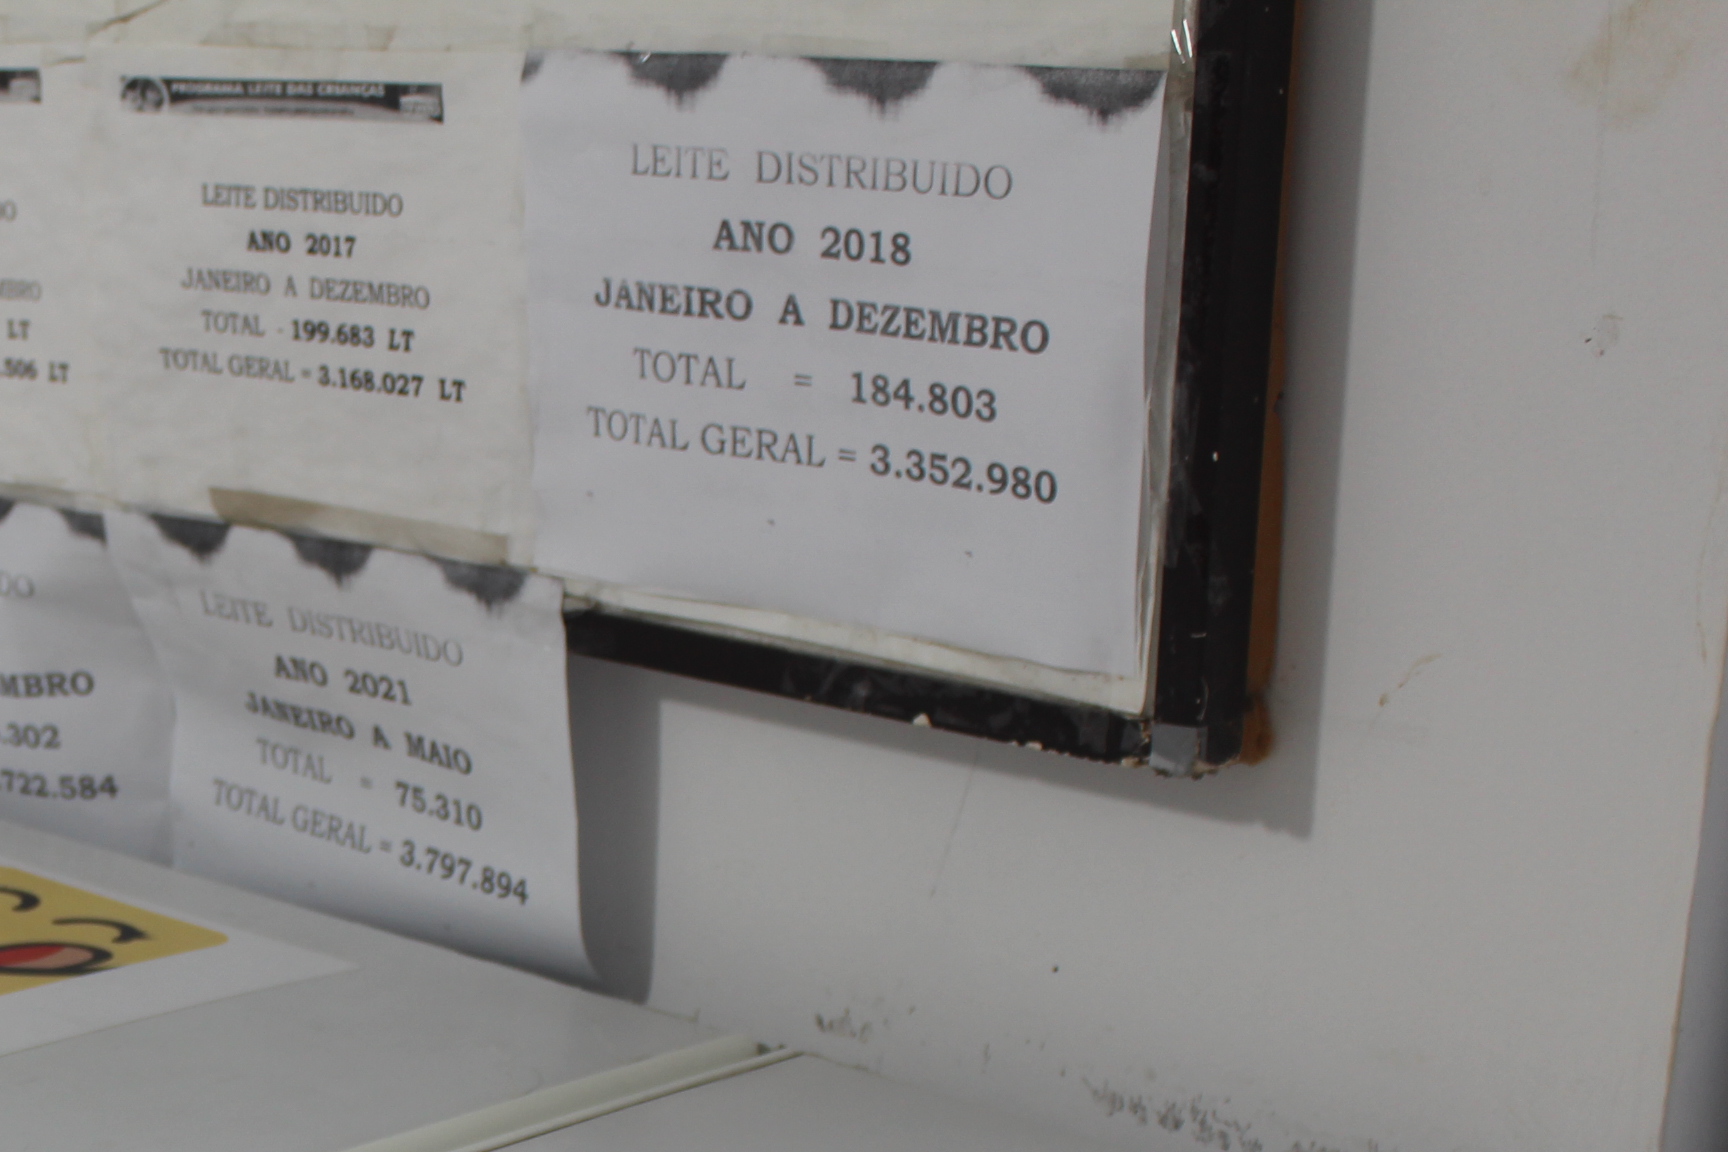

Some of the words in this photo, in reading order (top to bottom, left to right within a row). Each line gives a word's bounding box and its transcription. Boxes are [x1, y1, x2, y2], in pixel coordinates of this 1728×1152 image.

[631, 143, 730, 181] LEITE
[756, 150, 1013, 200] DISTRIBUIDO
[201, 183, 257, 210] LEITE
[264, 187, 403, 218] DISTRIBUIDO
[246, 231, 292, 254] ANO
[305, 234, 356, 258] 2017
[713, 219, 794, 255] ANO
[821, 226, 912, 267] 2018
[181, 267, 271, 296] JANEIRO
[284, 276, 298, 296] A
[309, 277, 430, 310] DEZEMBRO
[594, 277, 753, 321] JANEIRO
[779, 294, 805, 326] A
[829, 298, 1050, 355] DEZEMBRO
[8, 320, 30, 340] LT
[201, 310, 266, 337] TOTAL
[291, 319, 376, 348] 199.683
[388, 328, 414, 353] LT
[48, 362, 69, 384] LT
[159, 347, 222, 376] TOTAL
[228, 354, 295, 383] GERAL
[317, 364, 424, 397] 3.168.027
[438, 378, 466, 403] LT
[633, 347, 746, 391] TOTAL
[850, 372, 998, 423] 184.803
[586, 405, 689, 451] TOTAL
[701, 422, 826, 468] GERAL
[870, 444, 1058, 505] 3.352.980
[201, 591, 273, 628] LEITE
[287, 604, 463, 667] DISTRIBUIDO
[274, 654, 328, 687] ANO
[344, 668, 413, 706] 2021
[244, 692, 355, 740] JANEIRO
[372, 725, 392, 750] A
[405, 731, 472, 775] MAIO
[256, 738, 333, 785] TOTAL
[395, 780, 483, 832] 75.310
[212, 778, 286, 826] TOTAL
[292, 804, 372, 854] GERAL
[399, 840, 529, 904] 3.797.894
